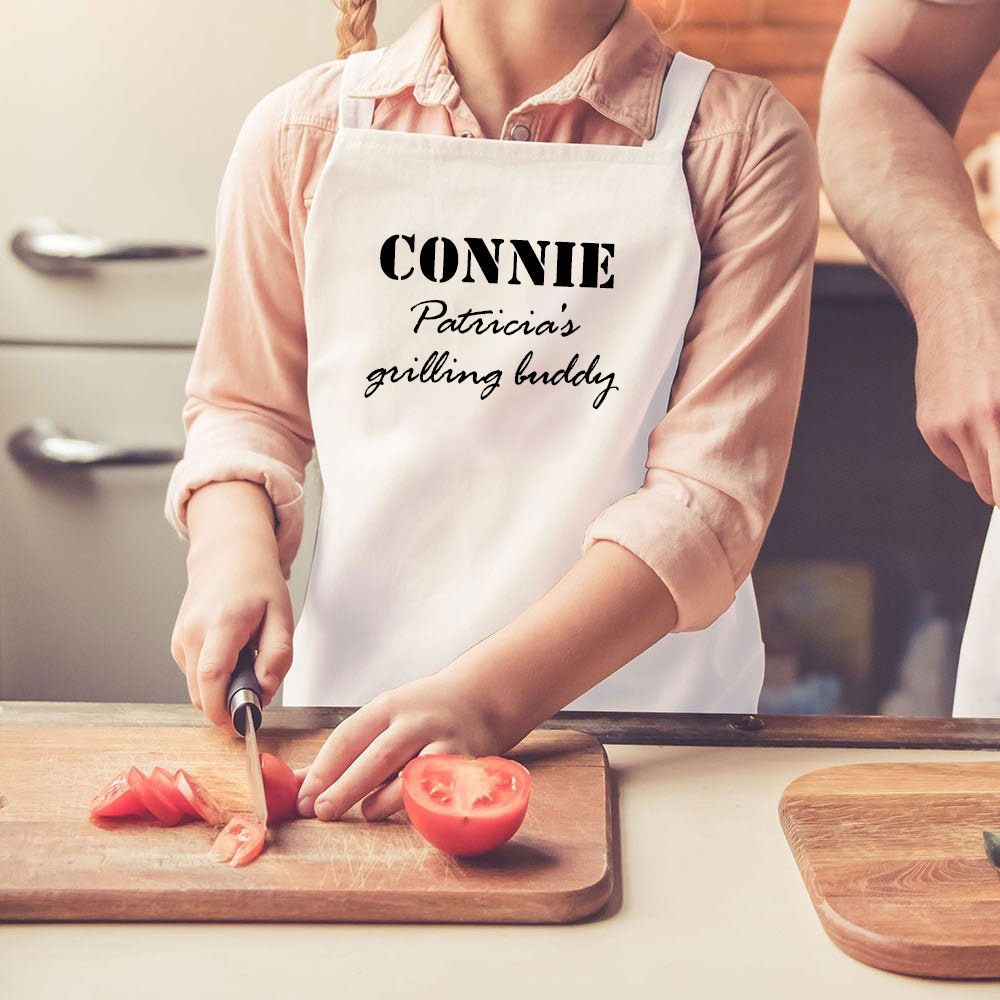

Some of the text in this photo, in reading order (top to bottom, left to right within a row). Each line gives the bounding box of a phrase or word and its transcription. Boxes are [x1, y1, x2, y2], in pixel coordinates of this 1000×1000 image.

[379, 233, 615, 289] CONNIE
[410, 299, 581, 338] Patricia's
[364, 350, 620, 410] grilling buddy
